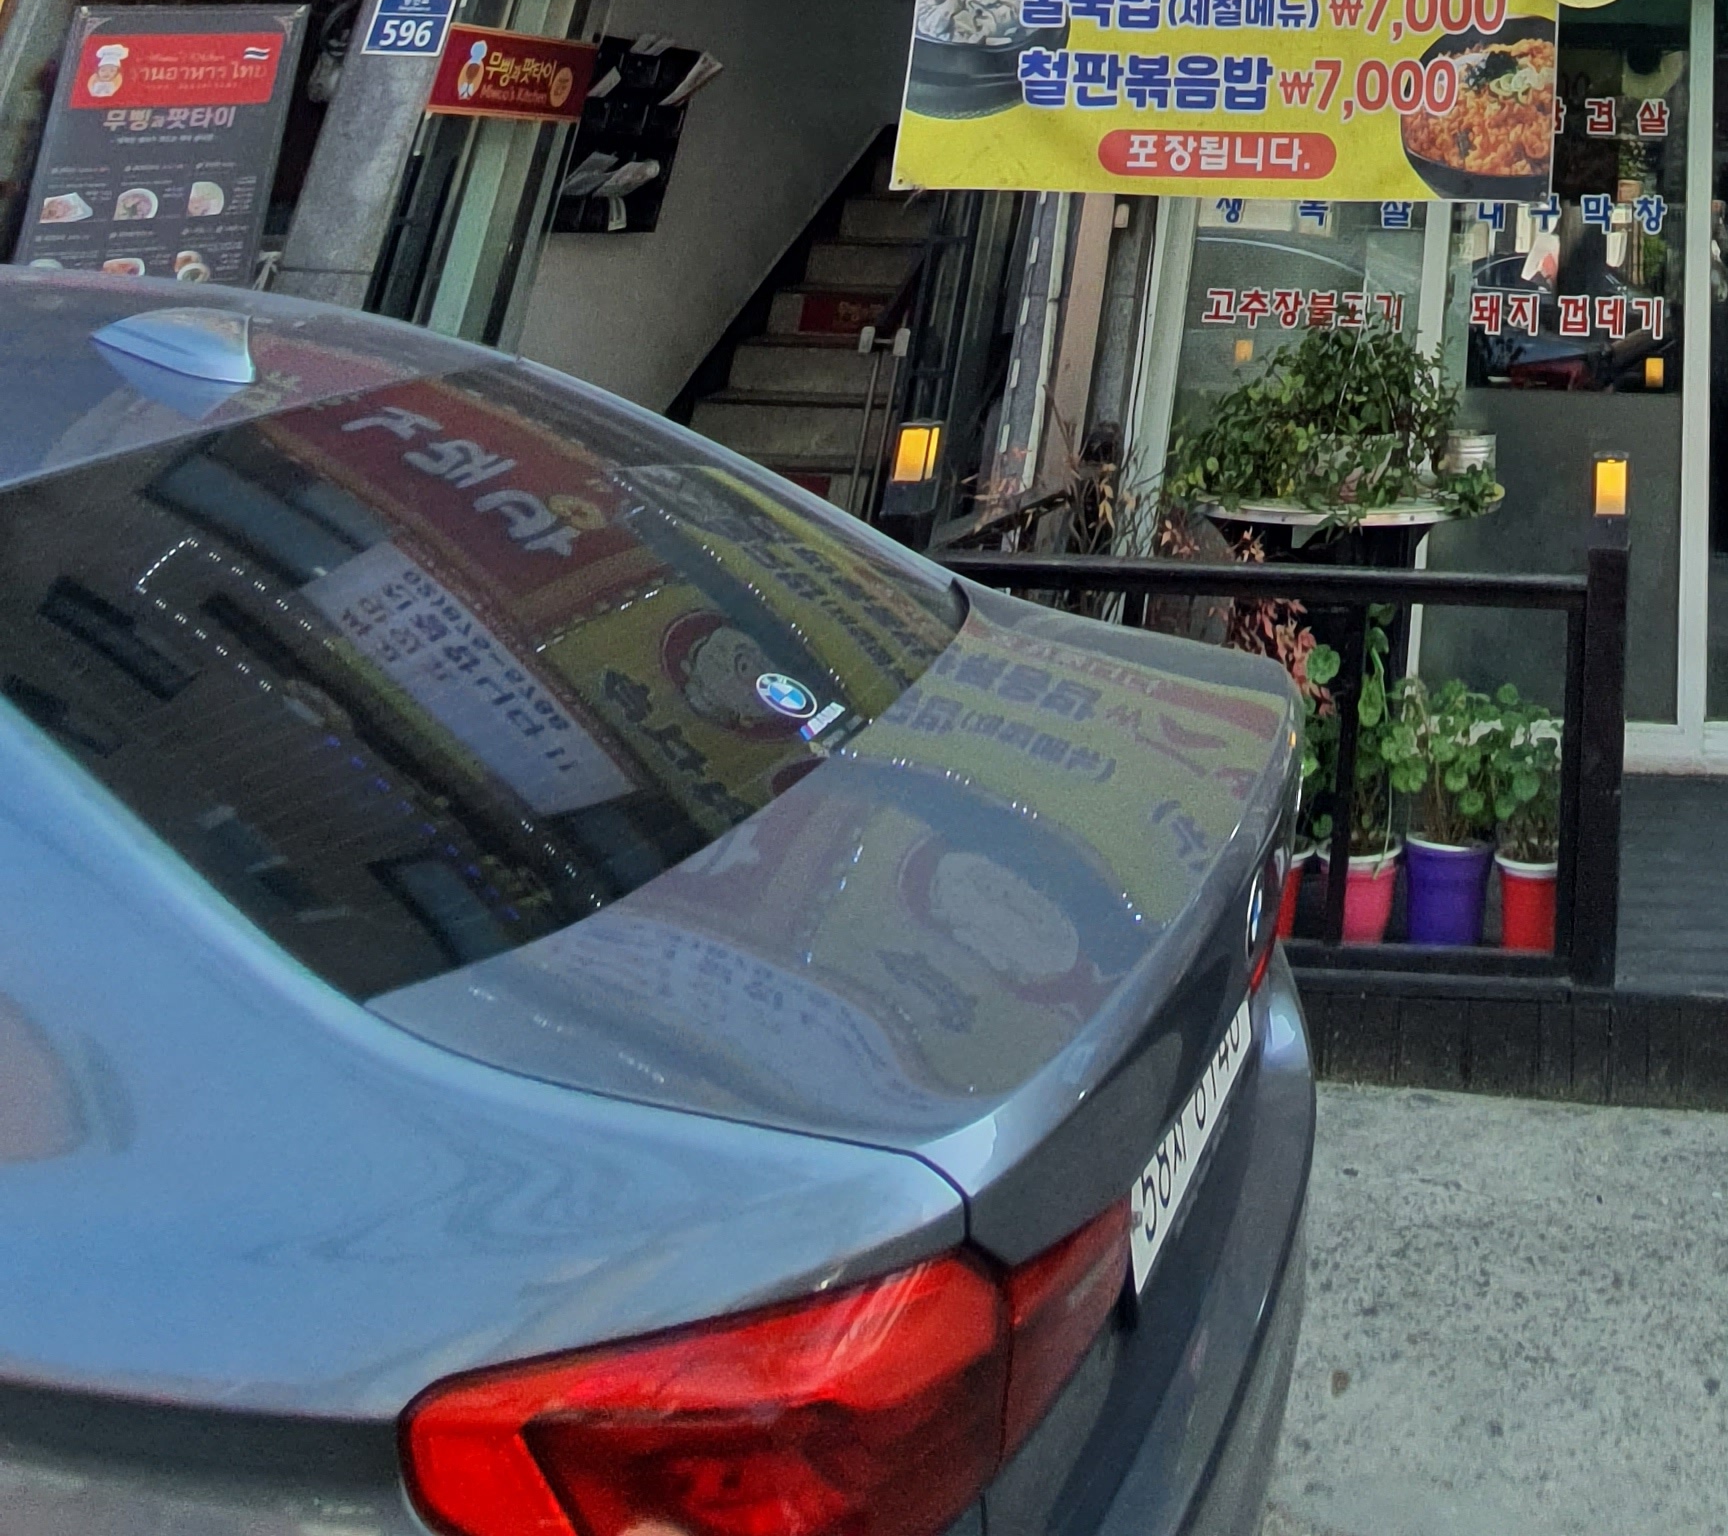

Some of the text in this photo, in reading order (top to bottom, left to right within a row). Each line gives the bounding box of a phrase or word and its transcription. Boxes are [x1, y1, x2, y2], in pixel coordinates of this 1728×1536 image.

[378, 19, 435, 48] 596
[1018, 50, 1275, 113] 철판볶음밥
[1126, 133, 1312, 173] 포장됩니다.
